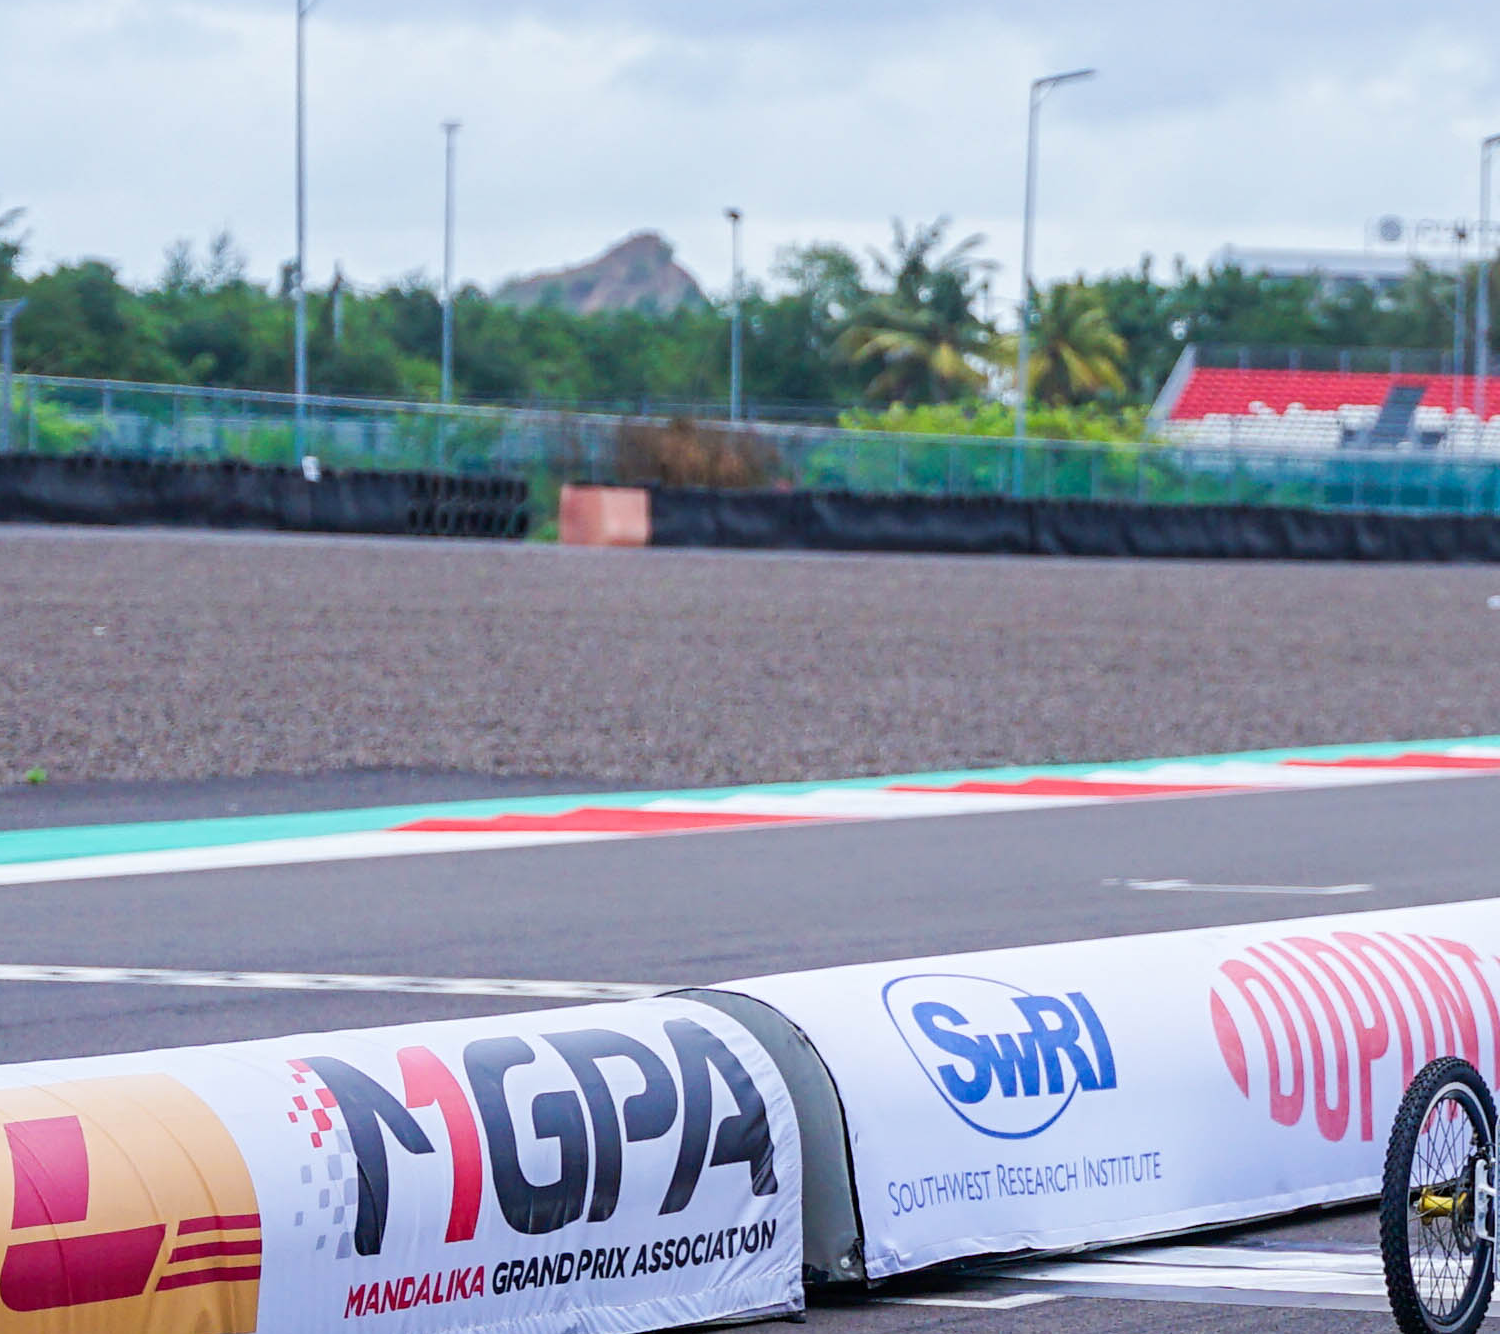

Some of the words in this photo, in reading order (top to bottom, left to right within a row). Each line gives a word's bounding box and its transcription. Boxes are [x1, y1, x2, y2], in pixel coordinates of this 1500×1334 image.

[911, 991, 1117, 1104] SwRI
[300, 1017, 778, 1255] MGPA
[344, 1265, 485, 1319] MANDALIKA
[491, 1251, 574, 1296] GRAND
[574, 1245, 630, 1282] PRIX
[631, 1218, 777, 1278] ASSOCIATION
